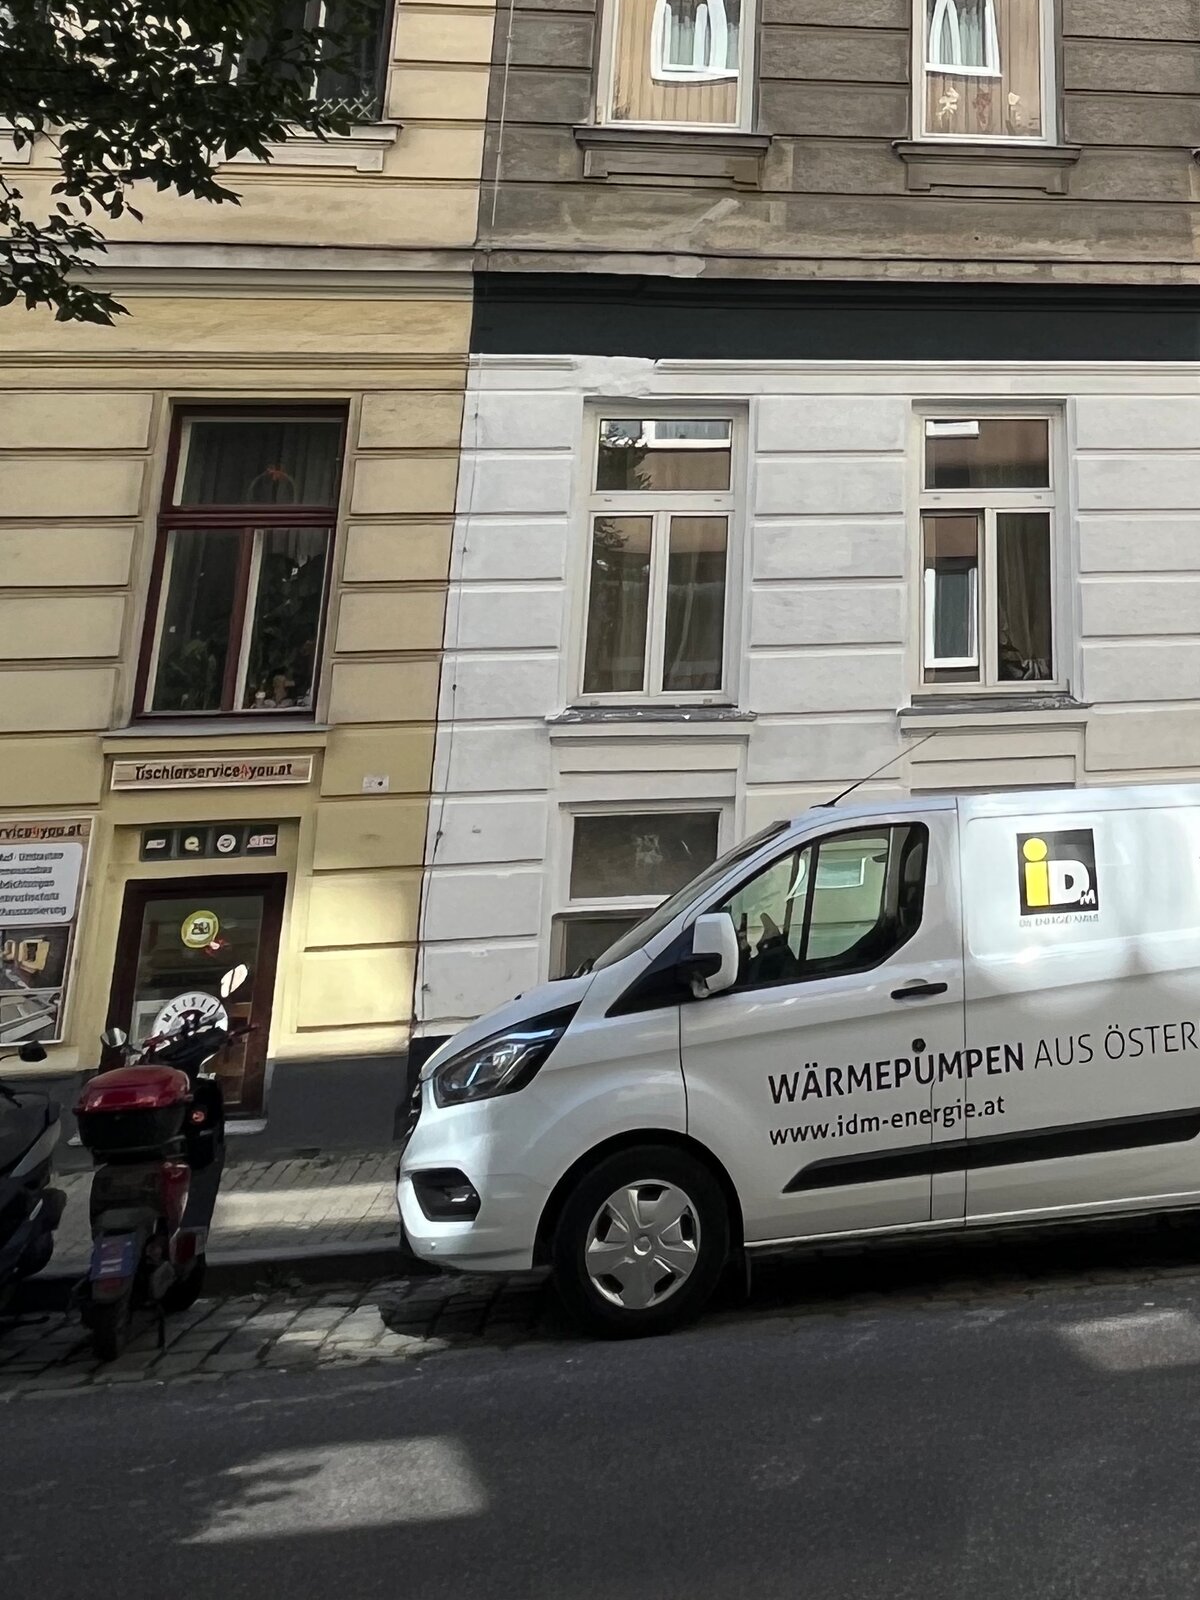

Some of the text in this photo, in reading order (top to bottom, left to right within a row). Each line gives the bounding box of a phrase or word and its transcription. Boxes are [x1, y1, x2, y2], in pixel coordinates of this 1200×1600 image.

[767, 1042, 1025, 1105] WÄRMEPUMPEN
[1034, 1033, 1094, 1069] AUS
[769, 1096, 1006, 1146] www.idm-energie.at
